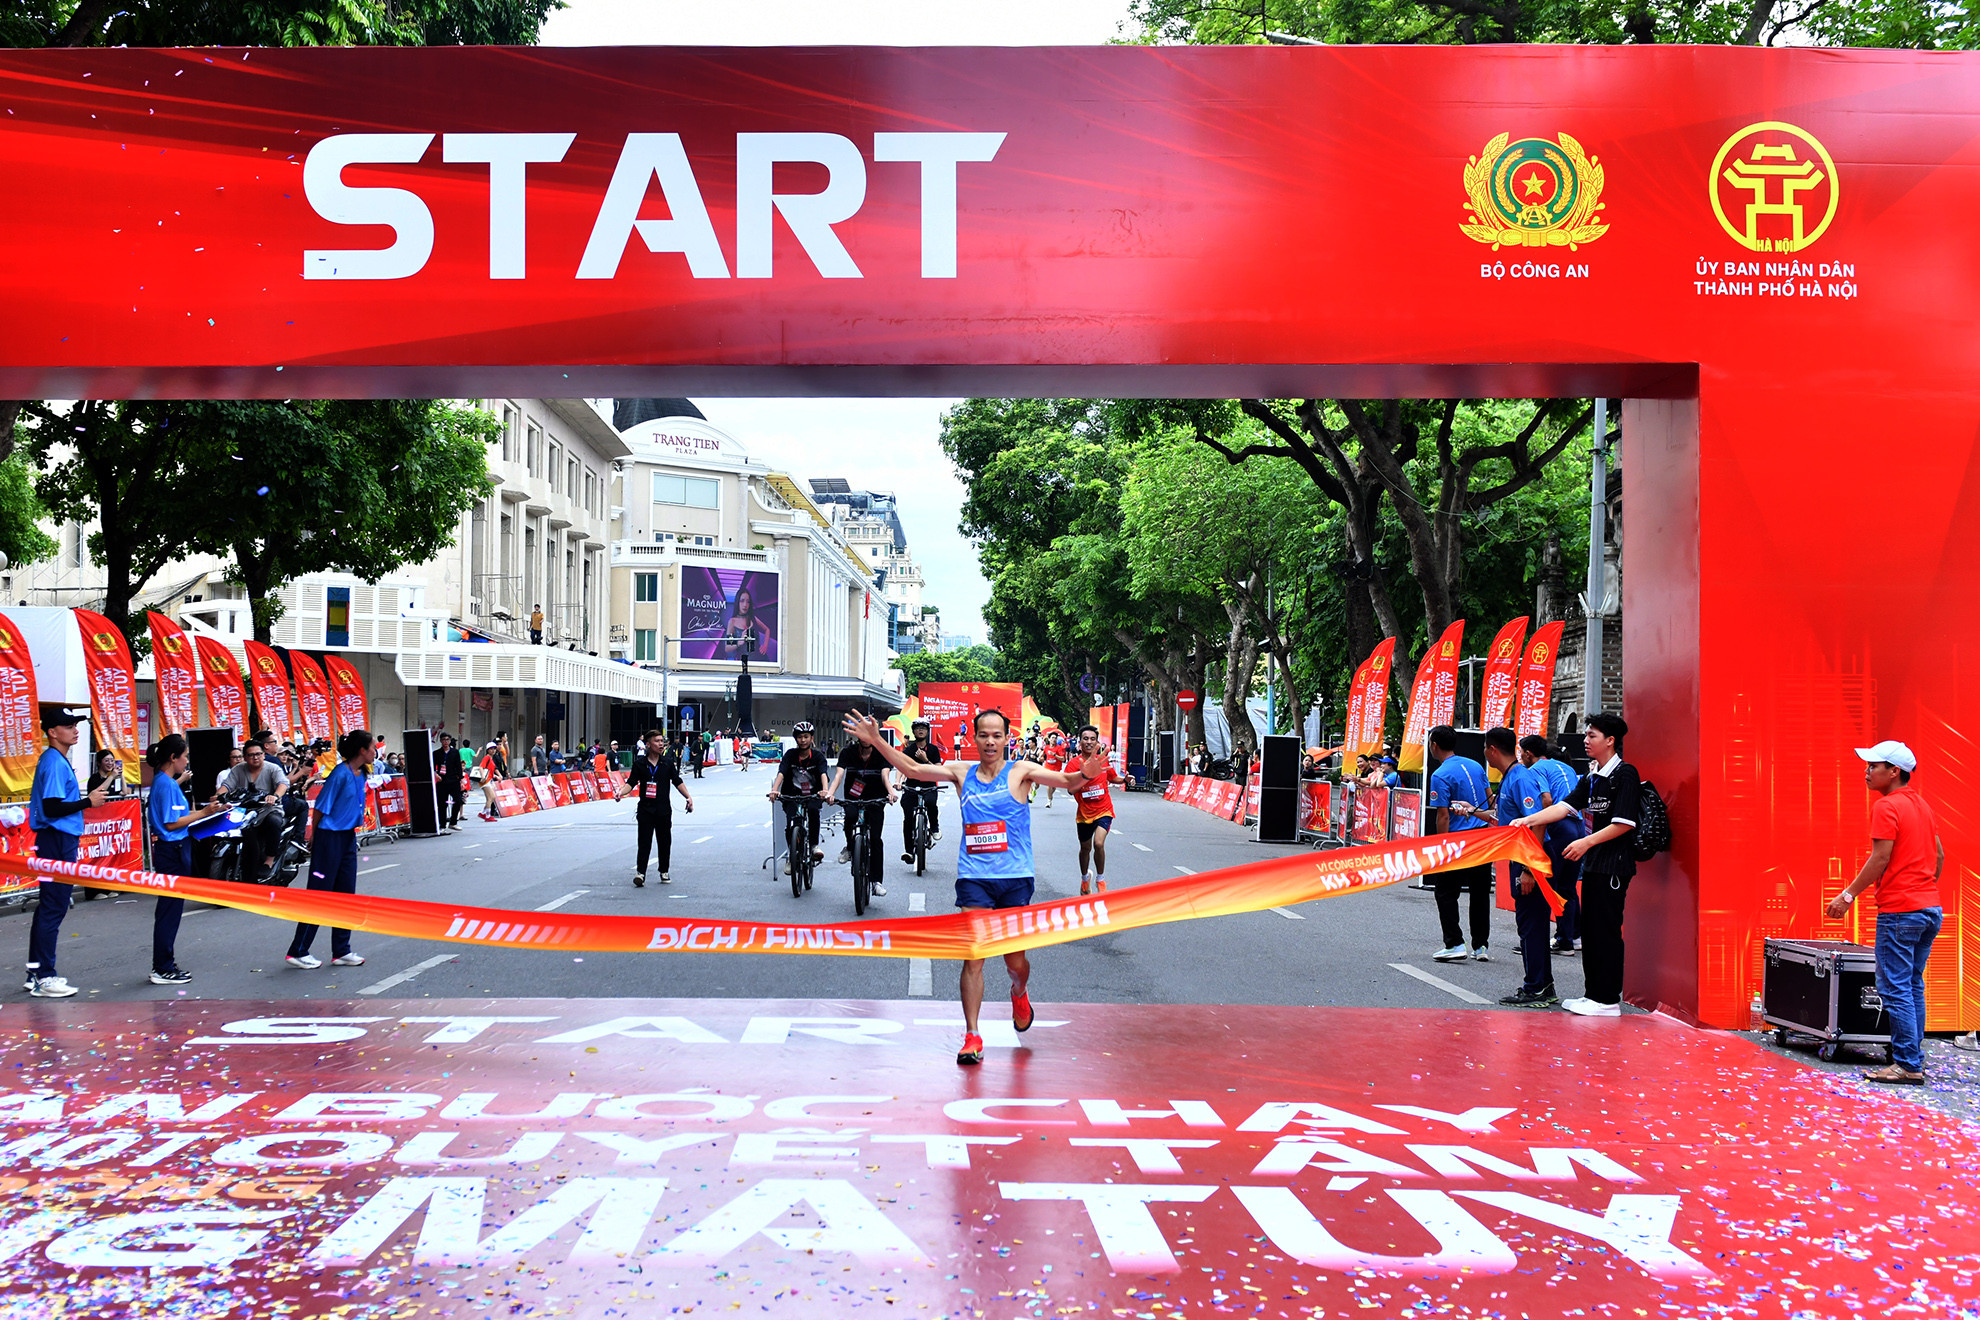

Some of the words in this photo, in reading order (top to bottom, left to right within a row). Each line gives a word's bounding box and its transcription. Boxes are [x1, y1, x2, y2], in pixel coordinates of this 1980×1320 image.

[302, 132, 1008, 279] START
[1756, 238, 1773, 253] HÀ
[1774, 237, 1795, 255] NỘI
[1480, 259, 1503, 281] BỘ
[1510, 260, 1560, 278] CÔNG
[1565, 264, 1590, 279] AN
[1695, 256, 1719, 276] ỦY
[1724, 262, 1760, 277] BAN
[1765, 260, 1814, 277] NHÂN
[1819, 260, 1855, 278] DÂN
[1693, 279, 1754, 296] THÀNH
[1758, 277, 1795, 297] PHỐ
[1799, 280, 1823, 297] HÀ
[1828, 281, 1858, 300] NỘI
[652, 432, 691, 447] TRANG
[693, 438, 720, 450] TIEN
[675, 447, 698, 455] PLAZA
[686, 598, 727, 609] MAGNUM
[14, 694, 30, 718] MA
[116, 693, 130, 714] MA
[179, 691, 192, 711] MA
[1373, 701, 1382, 717] MA
[1444, 694, 1454, 712] MA
[1496, 697, 1508, 716] MA
[230, 706, 242, 724] MA
[275, 704, 287, 721] MA
[318, 711, 329, 727] MA
[354, 711, 364, 726] MA
[1531, 707, 1544, 728] MA
[99, 834, 116, 857] MA
[973, 834, 998, 844] 10089
[1316, 863, 1328, 873] VÌ
[1382, 849, 1422, 883] MA
[646, 923, 739, 950] ĐÍCH
[187, 1016, 1072, 1047] START
[268, 1087, 898, 1124] BƯỚC
[942, 1097, 1518, 1136] CHẠY
[209, 1127, 1023, 1170] QUYẾT
[1068, 1133, 1648, 1183] TÂM
[302, 1176, 937, 1269] MA
[997, 1176, 1715, 1279] TÚY
